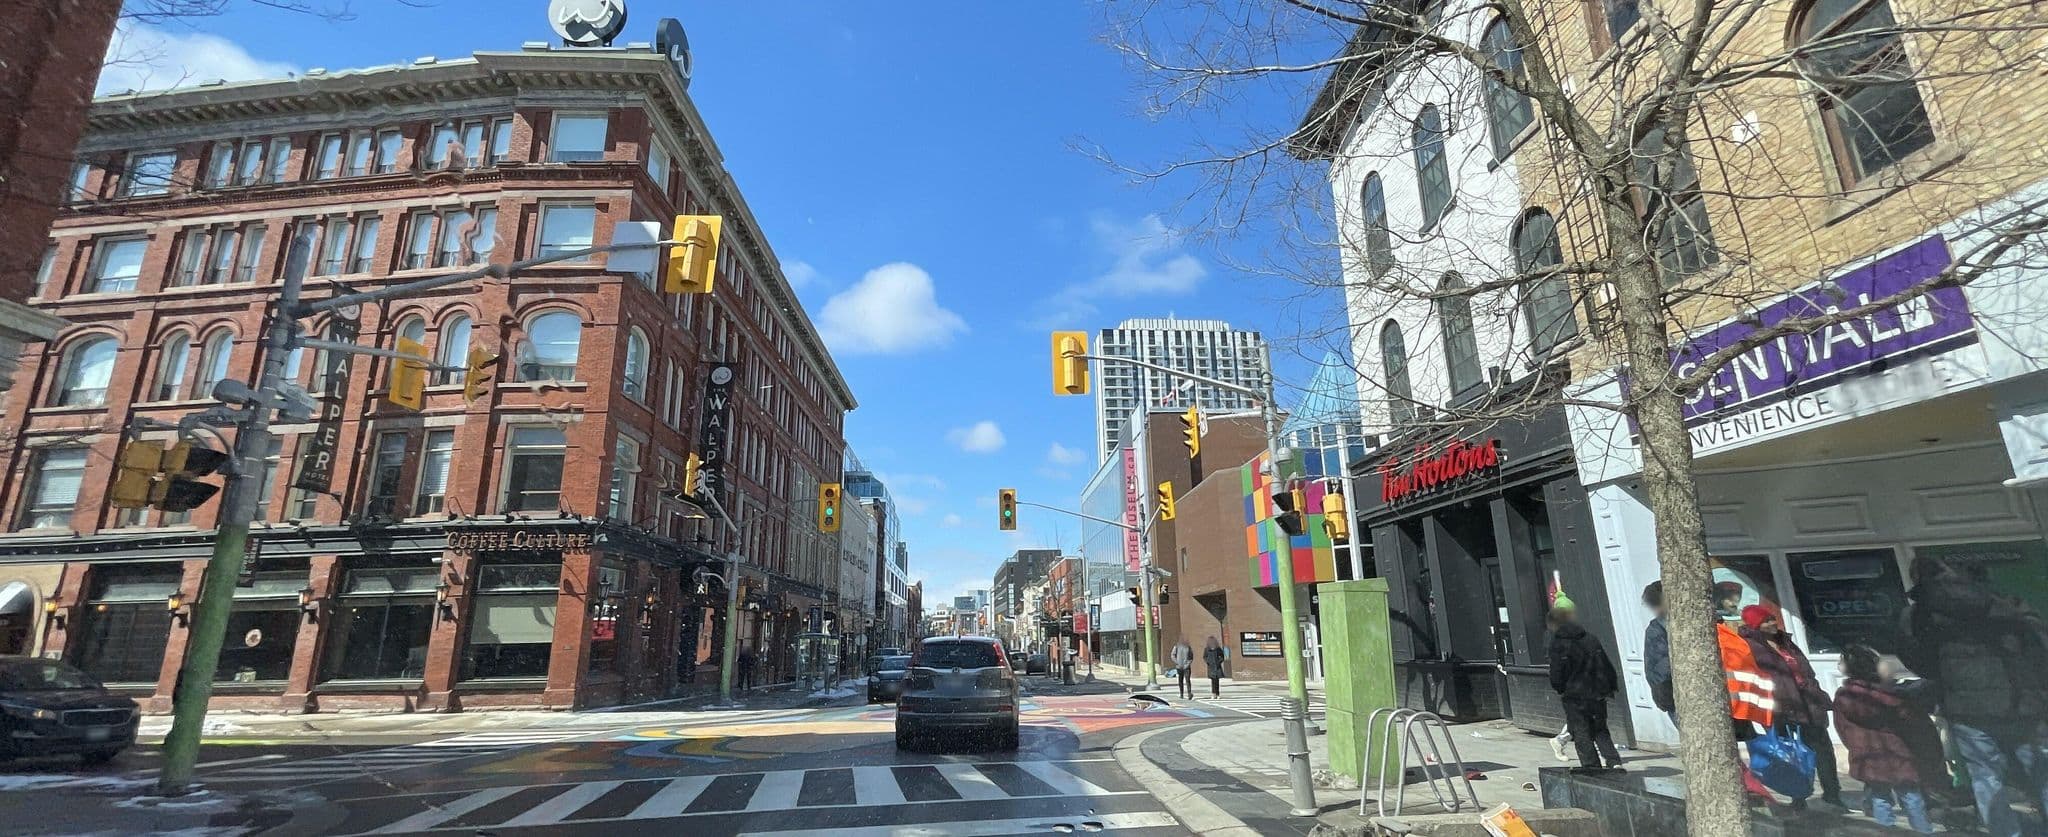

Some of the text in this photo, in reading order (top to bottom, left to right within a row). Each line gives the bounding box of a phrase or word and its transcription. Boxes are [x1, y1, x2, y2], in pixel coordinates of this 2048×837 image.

[1690, 391, 1834, 448] NVENIENCE
[1377, 437, 1498, 504] Tim Hortons
[447, 530, 588, 549] COFFEE CULTURE
